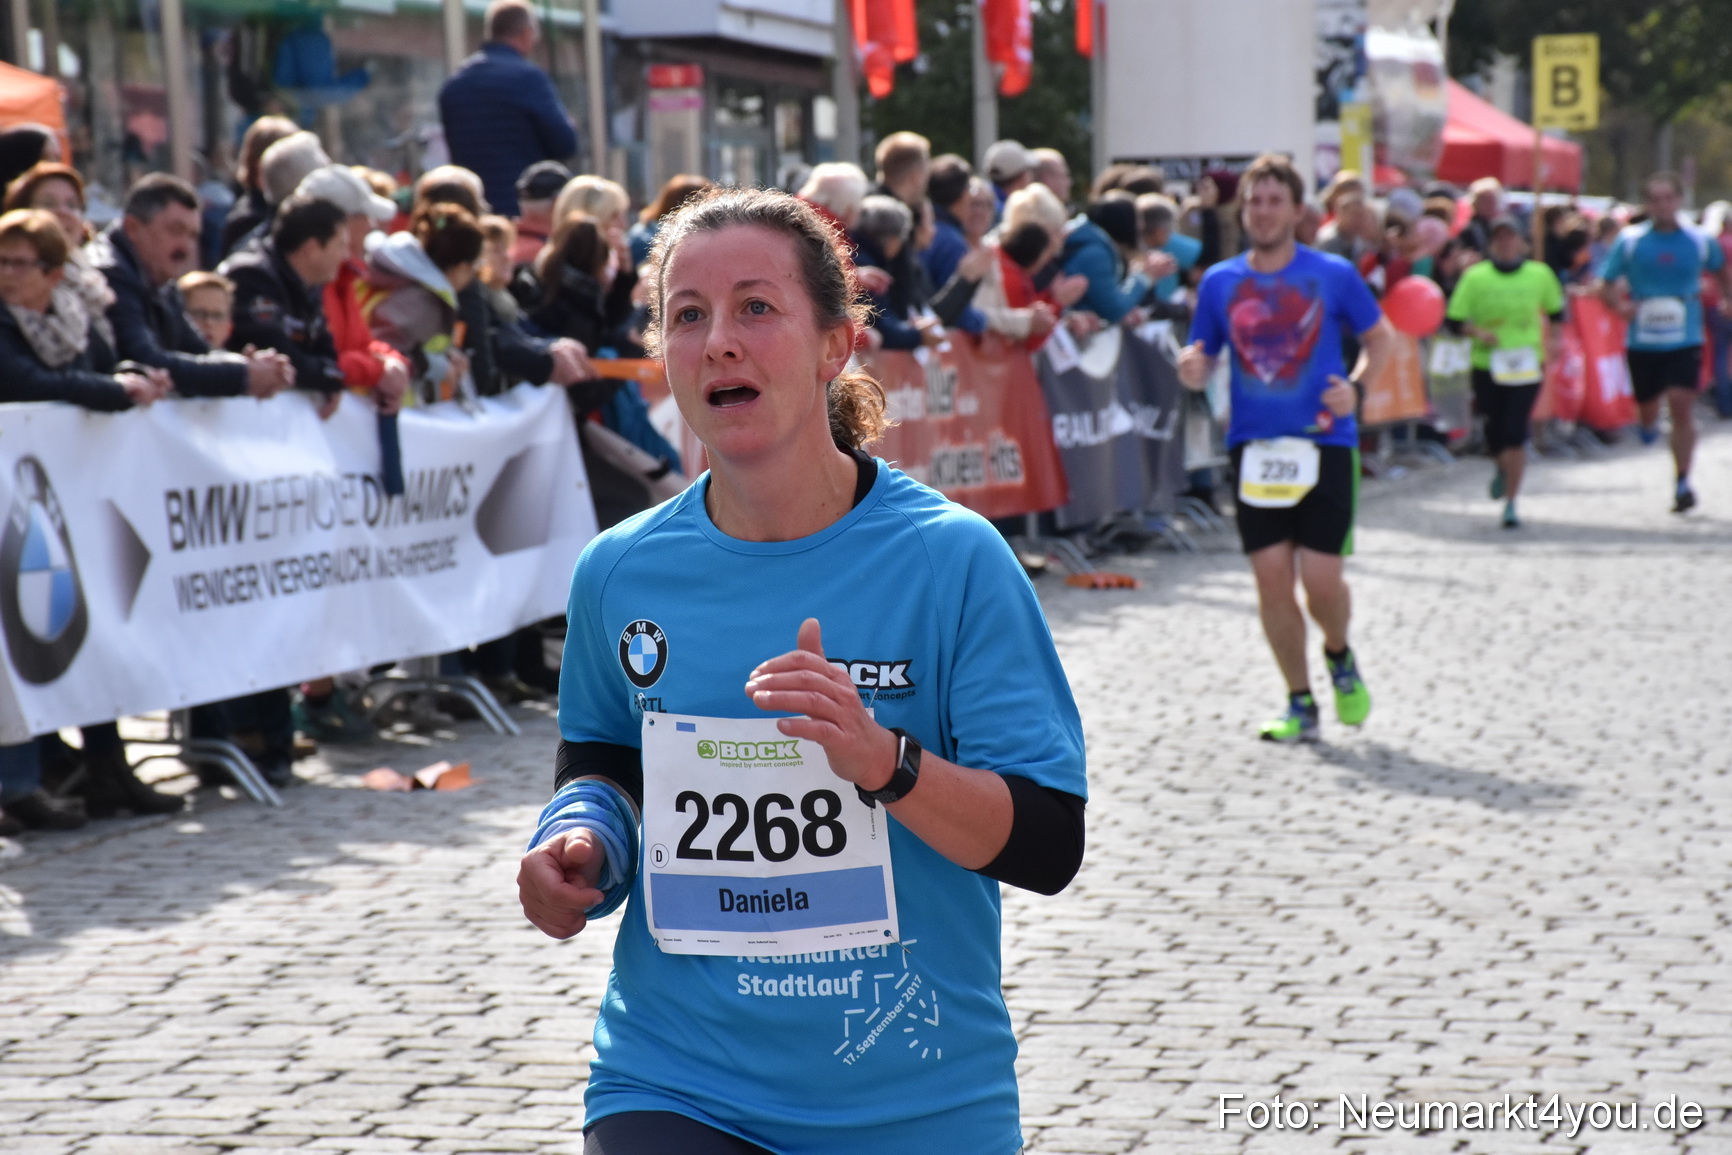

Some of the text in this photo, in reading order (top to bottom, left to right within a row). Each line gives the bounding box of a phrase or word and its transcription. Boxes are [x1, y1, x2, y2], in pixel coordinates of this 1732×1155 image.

[1551, 65, 1581, 109] B
[165, 483, 251, 552] BMW
[623, 622, 664, 644] BMW
[719, 740, 802, 760] BOCK
[720, 761, 742, 769] inspired
[744, 761, 751, 769] by
[774, 760, 804, 768] concepts
[675, 789, 847, 862] 2268
[656, 850, 662, 862] D
[719, 887, 809, 914] Daniela
[737, 970, 863, 998] Stadtlauf
[843, 974, 922, 1066] 17. September 2017
